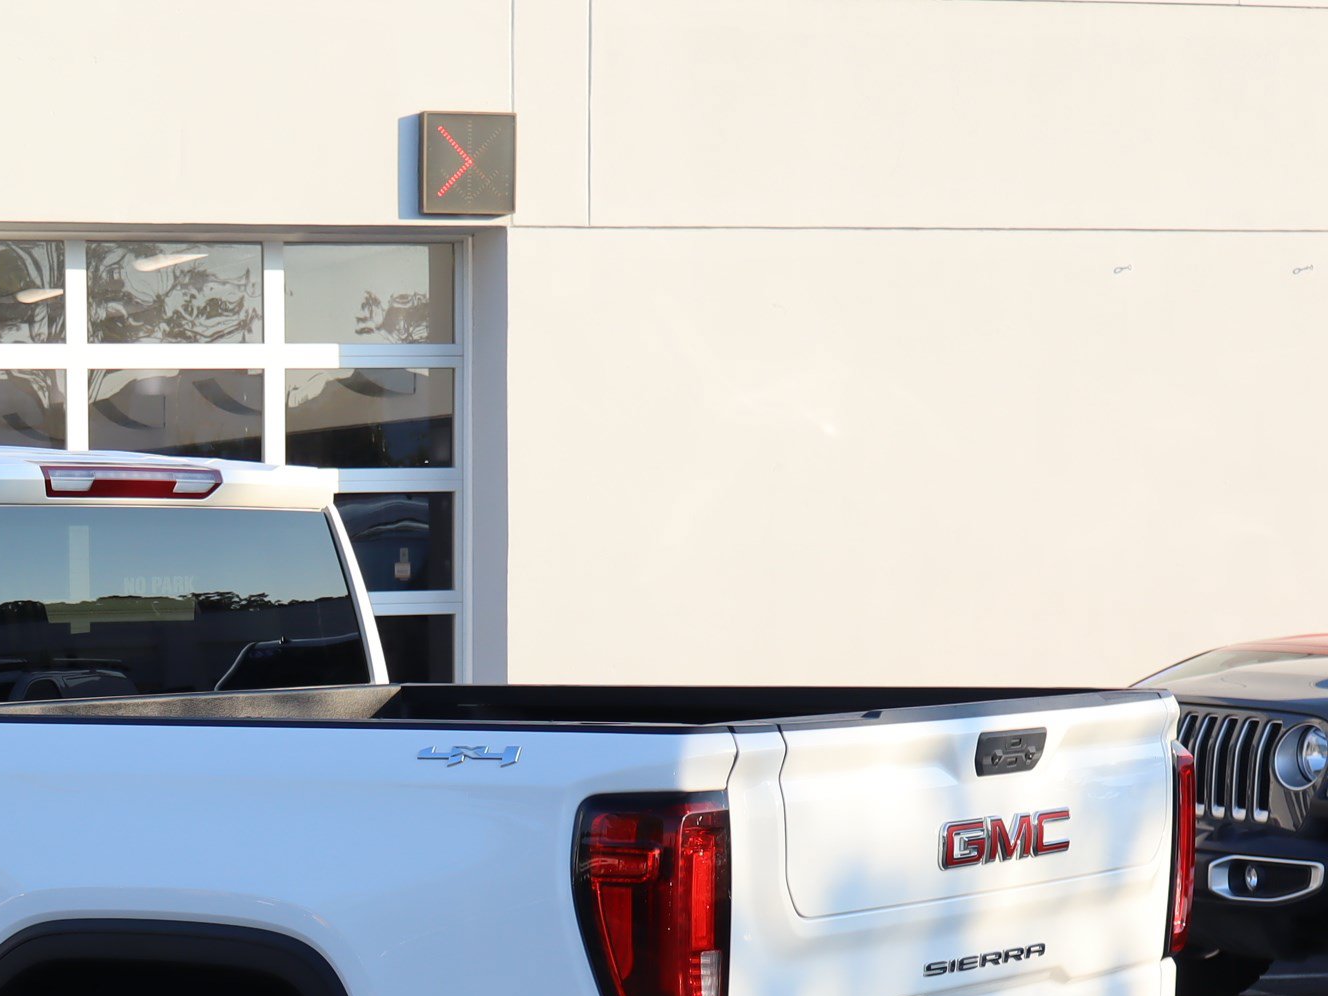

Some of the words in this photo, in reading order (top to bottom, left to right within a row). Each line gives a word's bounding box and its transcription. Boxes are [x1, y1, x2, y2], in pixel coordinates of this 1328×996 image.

[123, 576, 146, 595] NO
[938, 807, 1070, 871] GMC
[923, 943, 1046, 977] SIERRA
